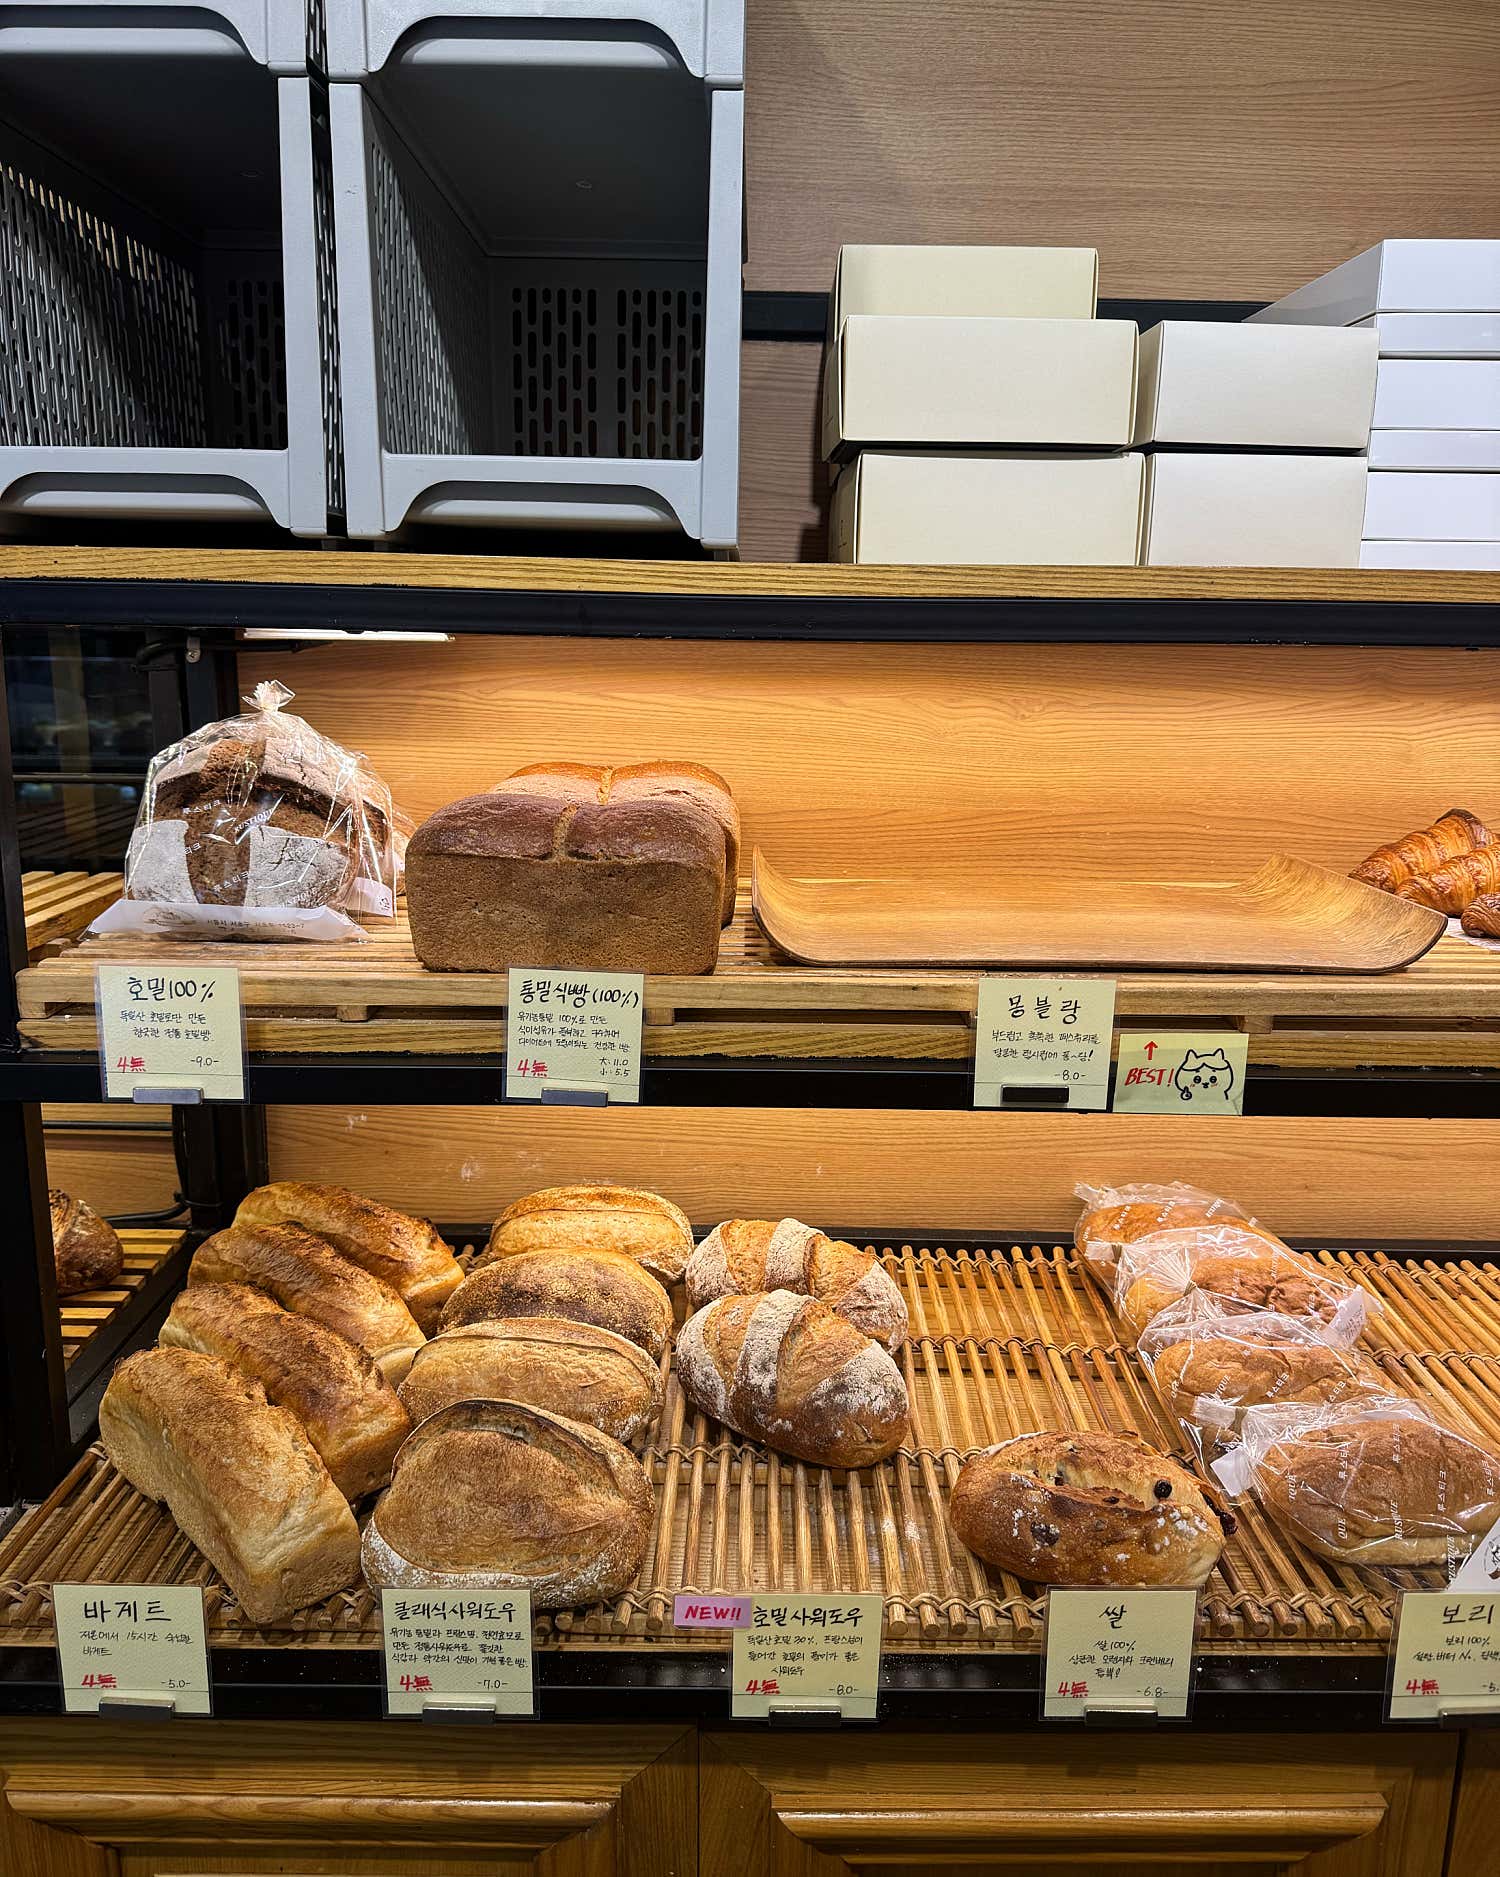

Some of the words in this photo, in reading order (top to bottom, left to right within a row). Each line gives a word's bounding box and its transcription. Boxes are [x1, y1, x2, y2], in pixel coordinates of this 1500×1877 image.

[188, 1012, 207, 1024] 만든
[992, 1029, 1023, 1042] 부드럽고
[1124, 1067, 1175, 1088] BEST!
[1265, 1372, 1290, 1399] 루스티크
[1437, 1469, 1448, 1512] 루스티크
[83, 1600, 172, 1623] 바게트
[684, 1605, 741, 1621] NEW!!
[1098, 1604, 1128, 1629] 쌀
[1442, 1604, 1495, 1625] 보리
[79, 1629, 119, 1642] 저온에서
[126, 1631, 159, 1642] 15시간
[82, 1646, 113, 1657] 바게트
[1102, 1655, 1134, 1666] 오렌지와
